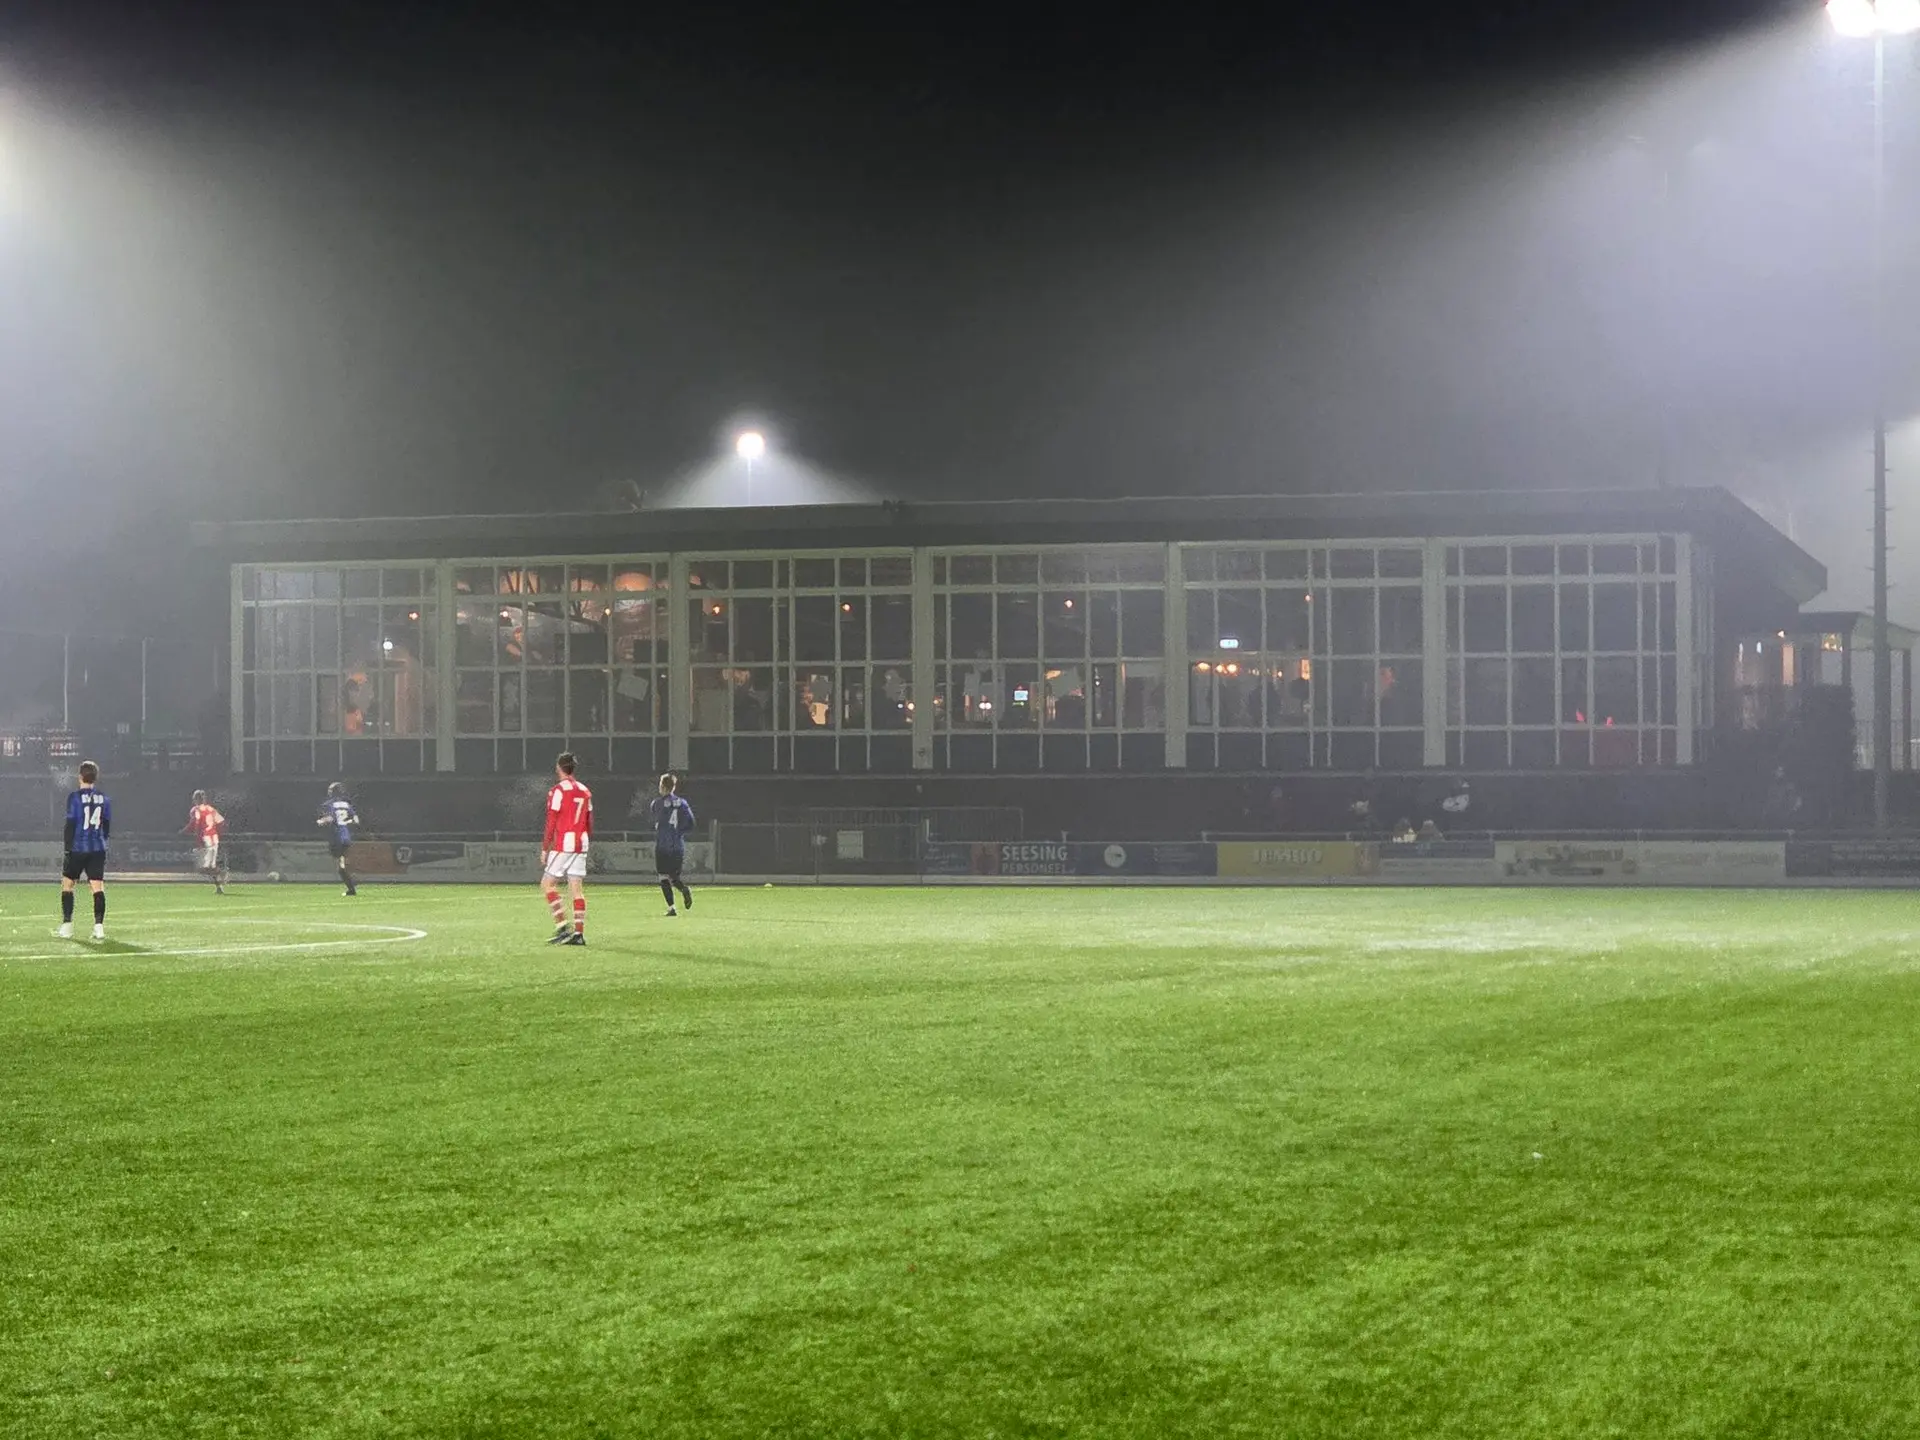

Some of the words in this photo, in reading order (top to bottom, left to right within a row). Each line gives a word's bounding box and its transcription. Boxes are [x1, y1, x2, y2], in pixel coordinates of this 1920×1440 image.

[83, 805, 102, 831] 14
[573, 797, 584, 825] 7
[668, 808, 679, 829] 4
[1001, 845, 1069, 861] SEESING
